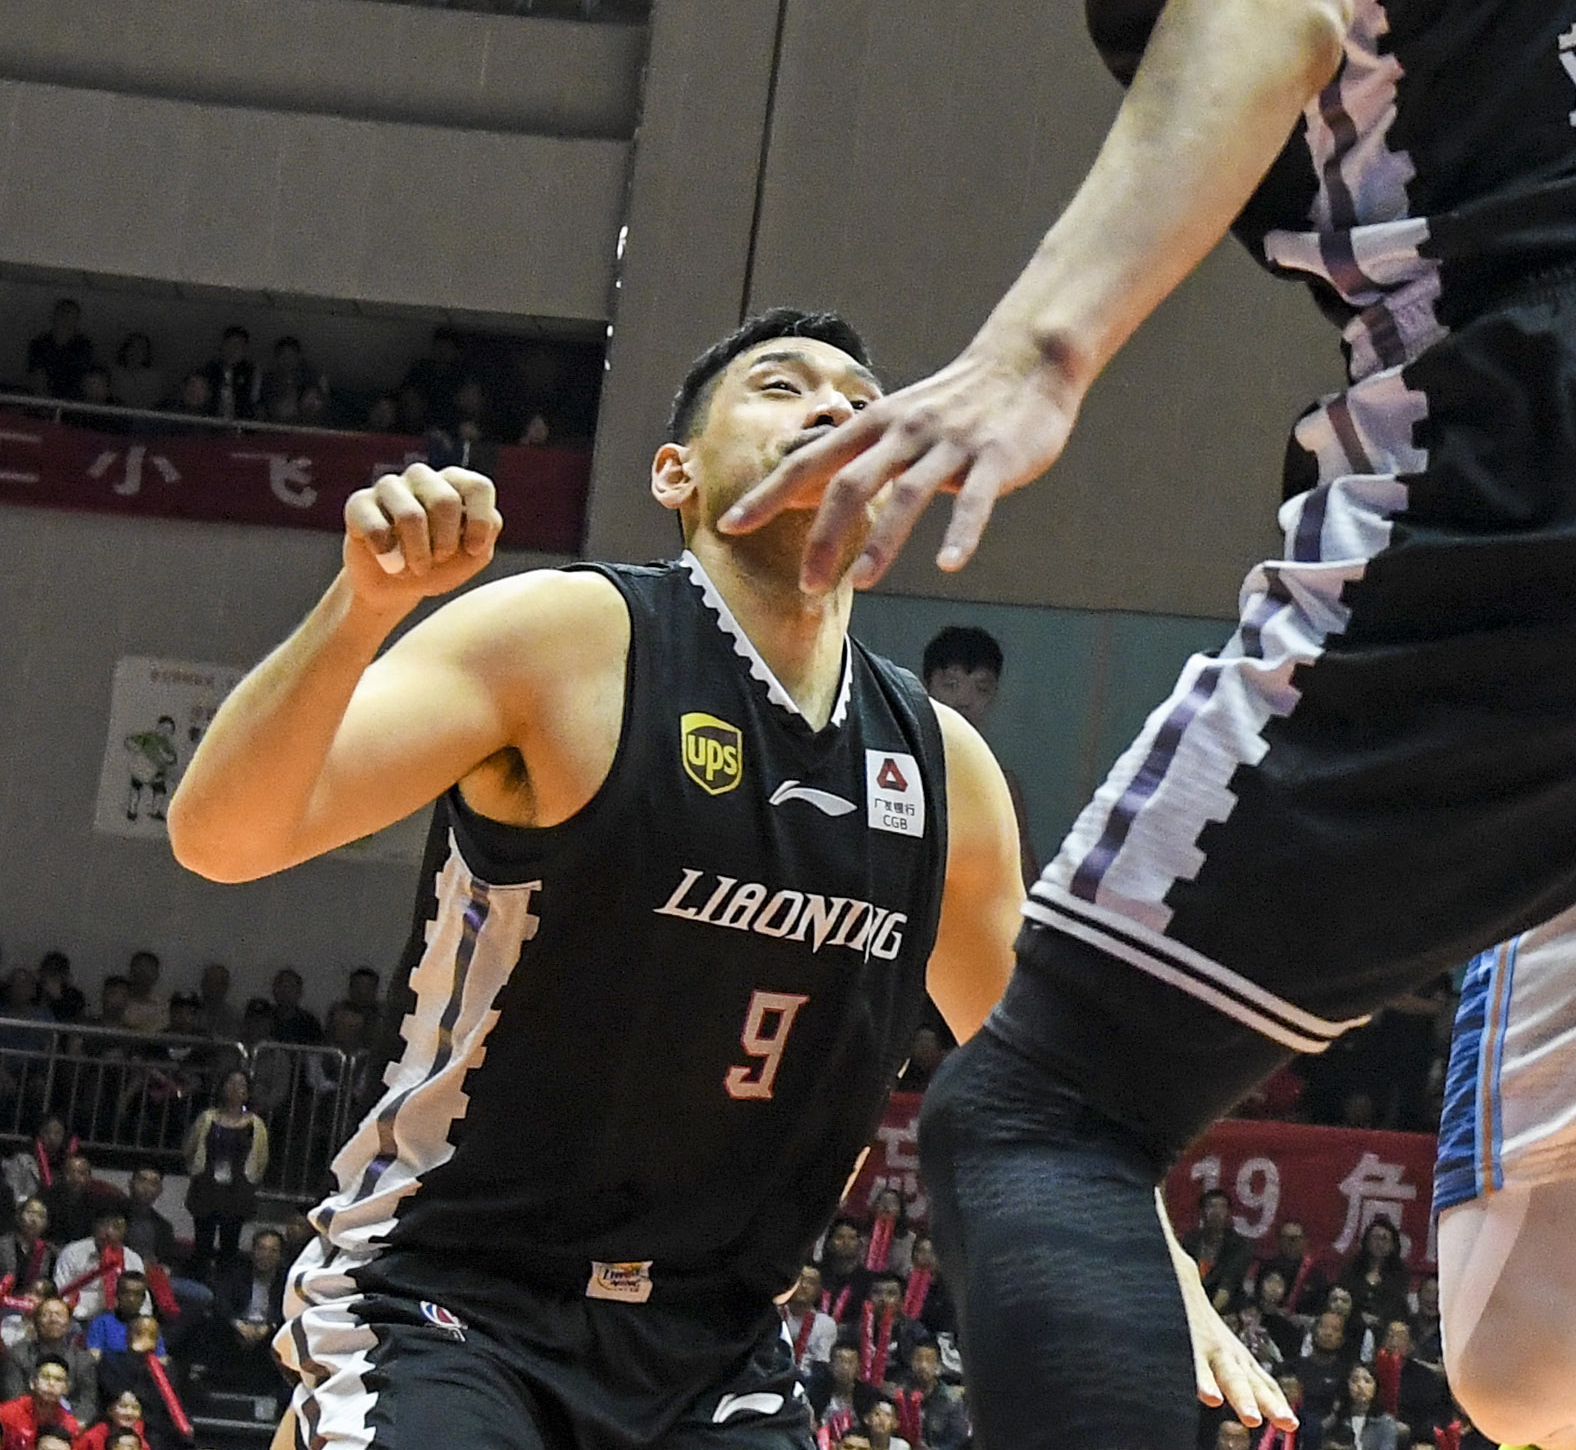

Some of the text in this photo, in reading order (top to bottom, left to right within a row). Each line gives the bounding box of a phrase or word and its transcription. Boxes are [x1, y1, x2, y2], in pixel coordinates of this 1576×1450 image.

[687, 734, 738, 781] ups
[883, 815, 908, 830] CGB
[654, 868, 908, 963] LIAONING
[723, 990, 810, 1099] 9
